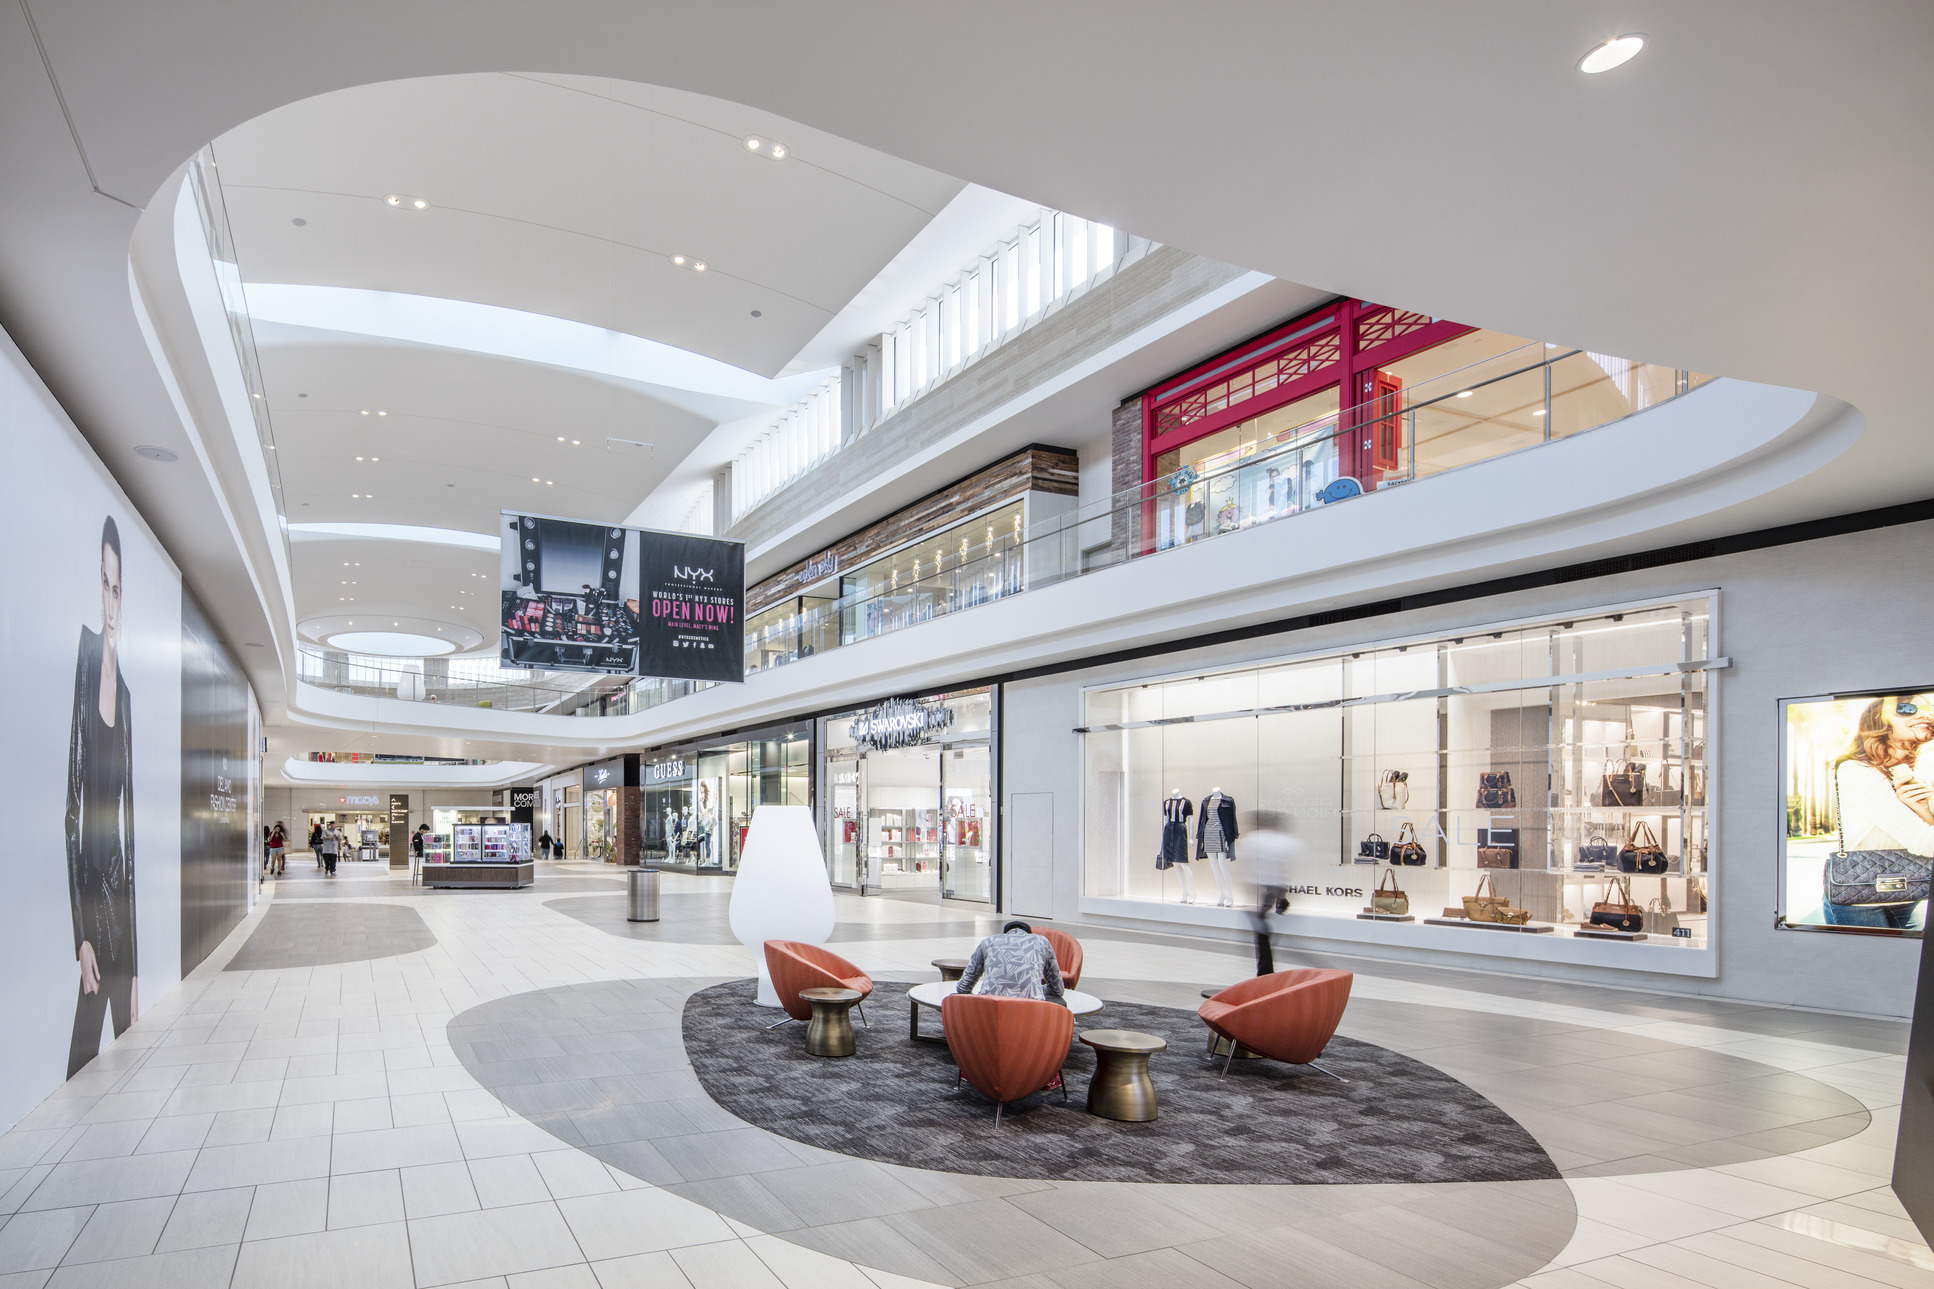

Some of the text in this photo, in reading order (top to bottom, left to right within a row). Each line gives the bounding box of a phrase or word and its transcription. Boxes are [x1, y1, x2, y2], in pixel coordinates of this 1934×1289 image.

[674, 565, 714, 584] NYX
[652, 590, 683, 601] WORLD'S
[695, 595, 708, 603] NYX
[710, 596, 734, 606] STORES
[652, 599, 734, 624] OPEN NOW!
[870, 712, 925, 734] SWAROVSKI
[654, 760, 684, 779] GUESS
[513, 793, 534, 801] MOR
[513, 800, 534, 808] COM
[833, 806, 851, 819] SALE
[950, 803, 976, 818] SALE
[1389, 815, 1515, 847] SALE
[1288, 885, 1364, 898] HAEL KORS
[1673, 928, 1691, 938] 411
